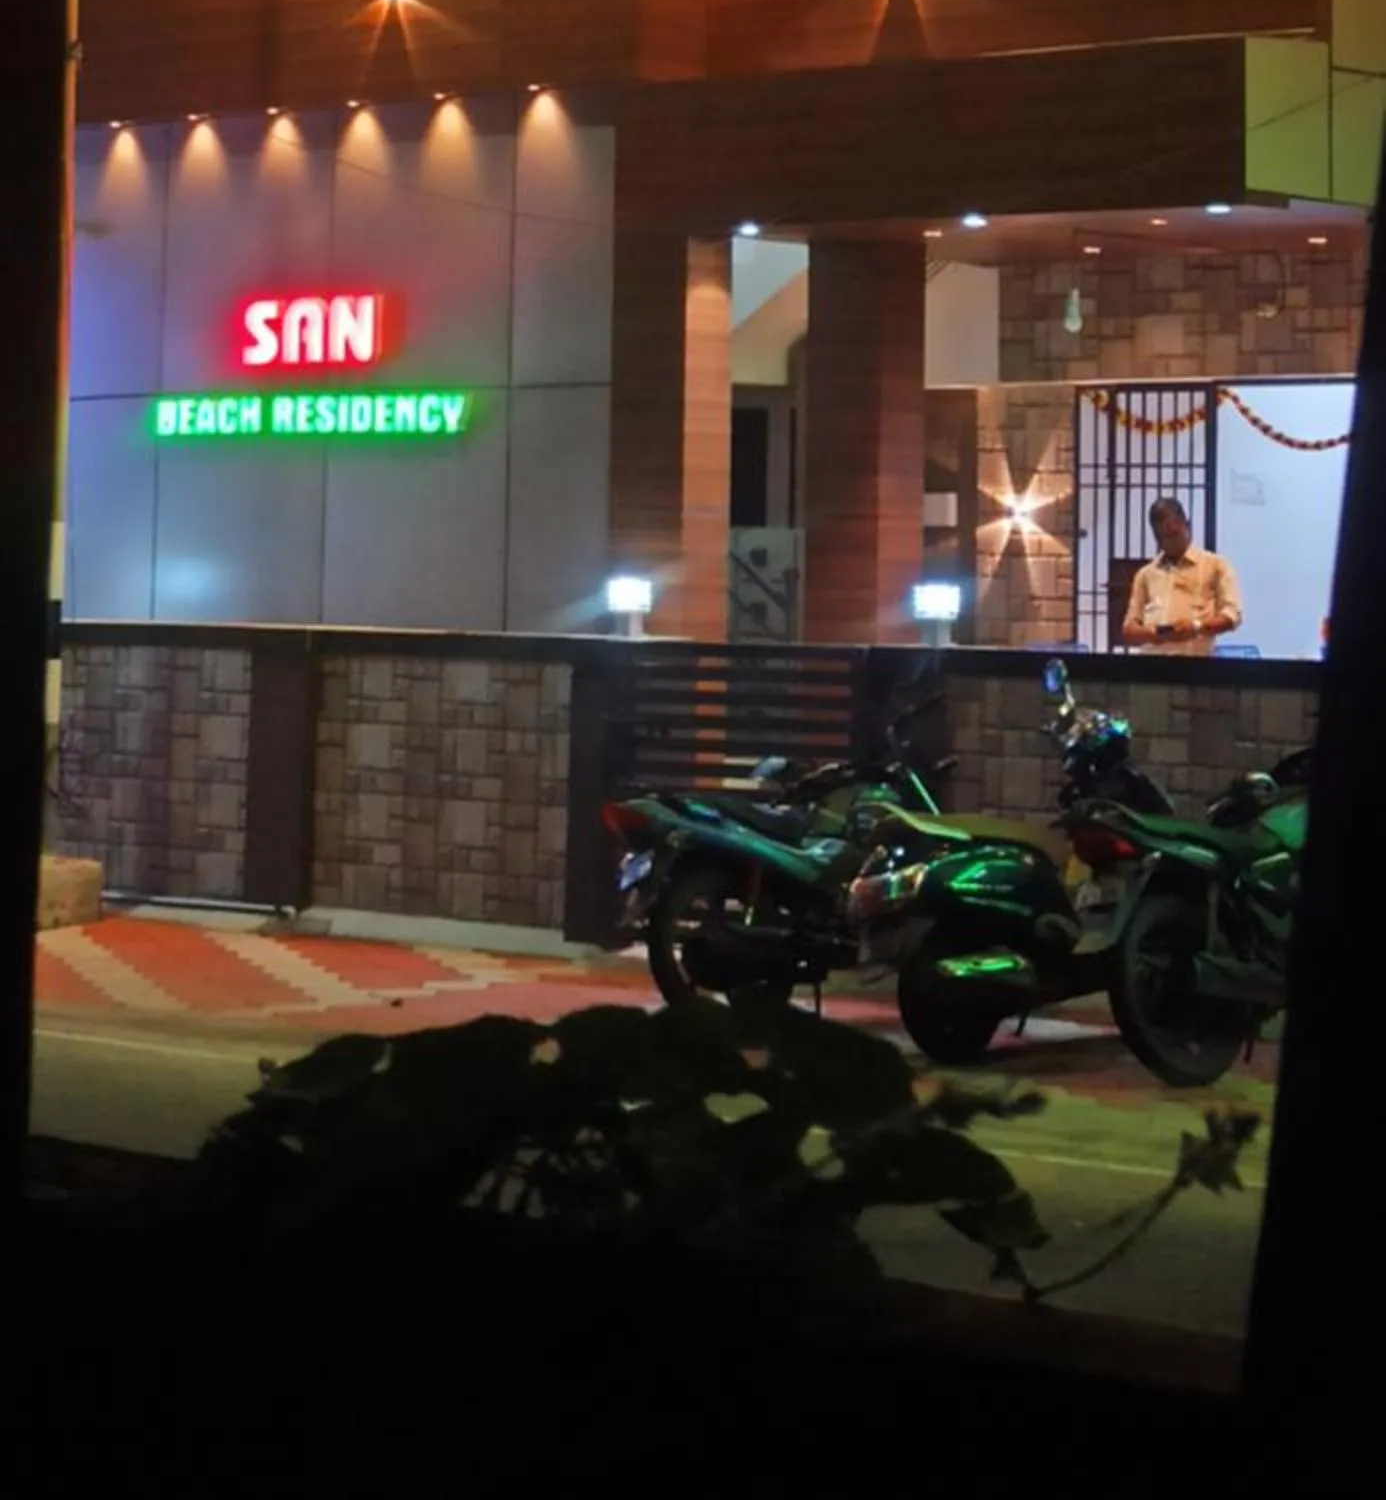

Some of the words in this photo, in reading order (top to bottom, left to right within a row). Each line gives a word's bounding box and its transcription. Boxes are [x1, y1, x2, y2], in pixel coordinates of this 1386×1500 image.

[242, 295, 377, 365] SAN
[156, 396, 262, 436] BEACH
[271, 393, 467, 434] RESIDENCY
